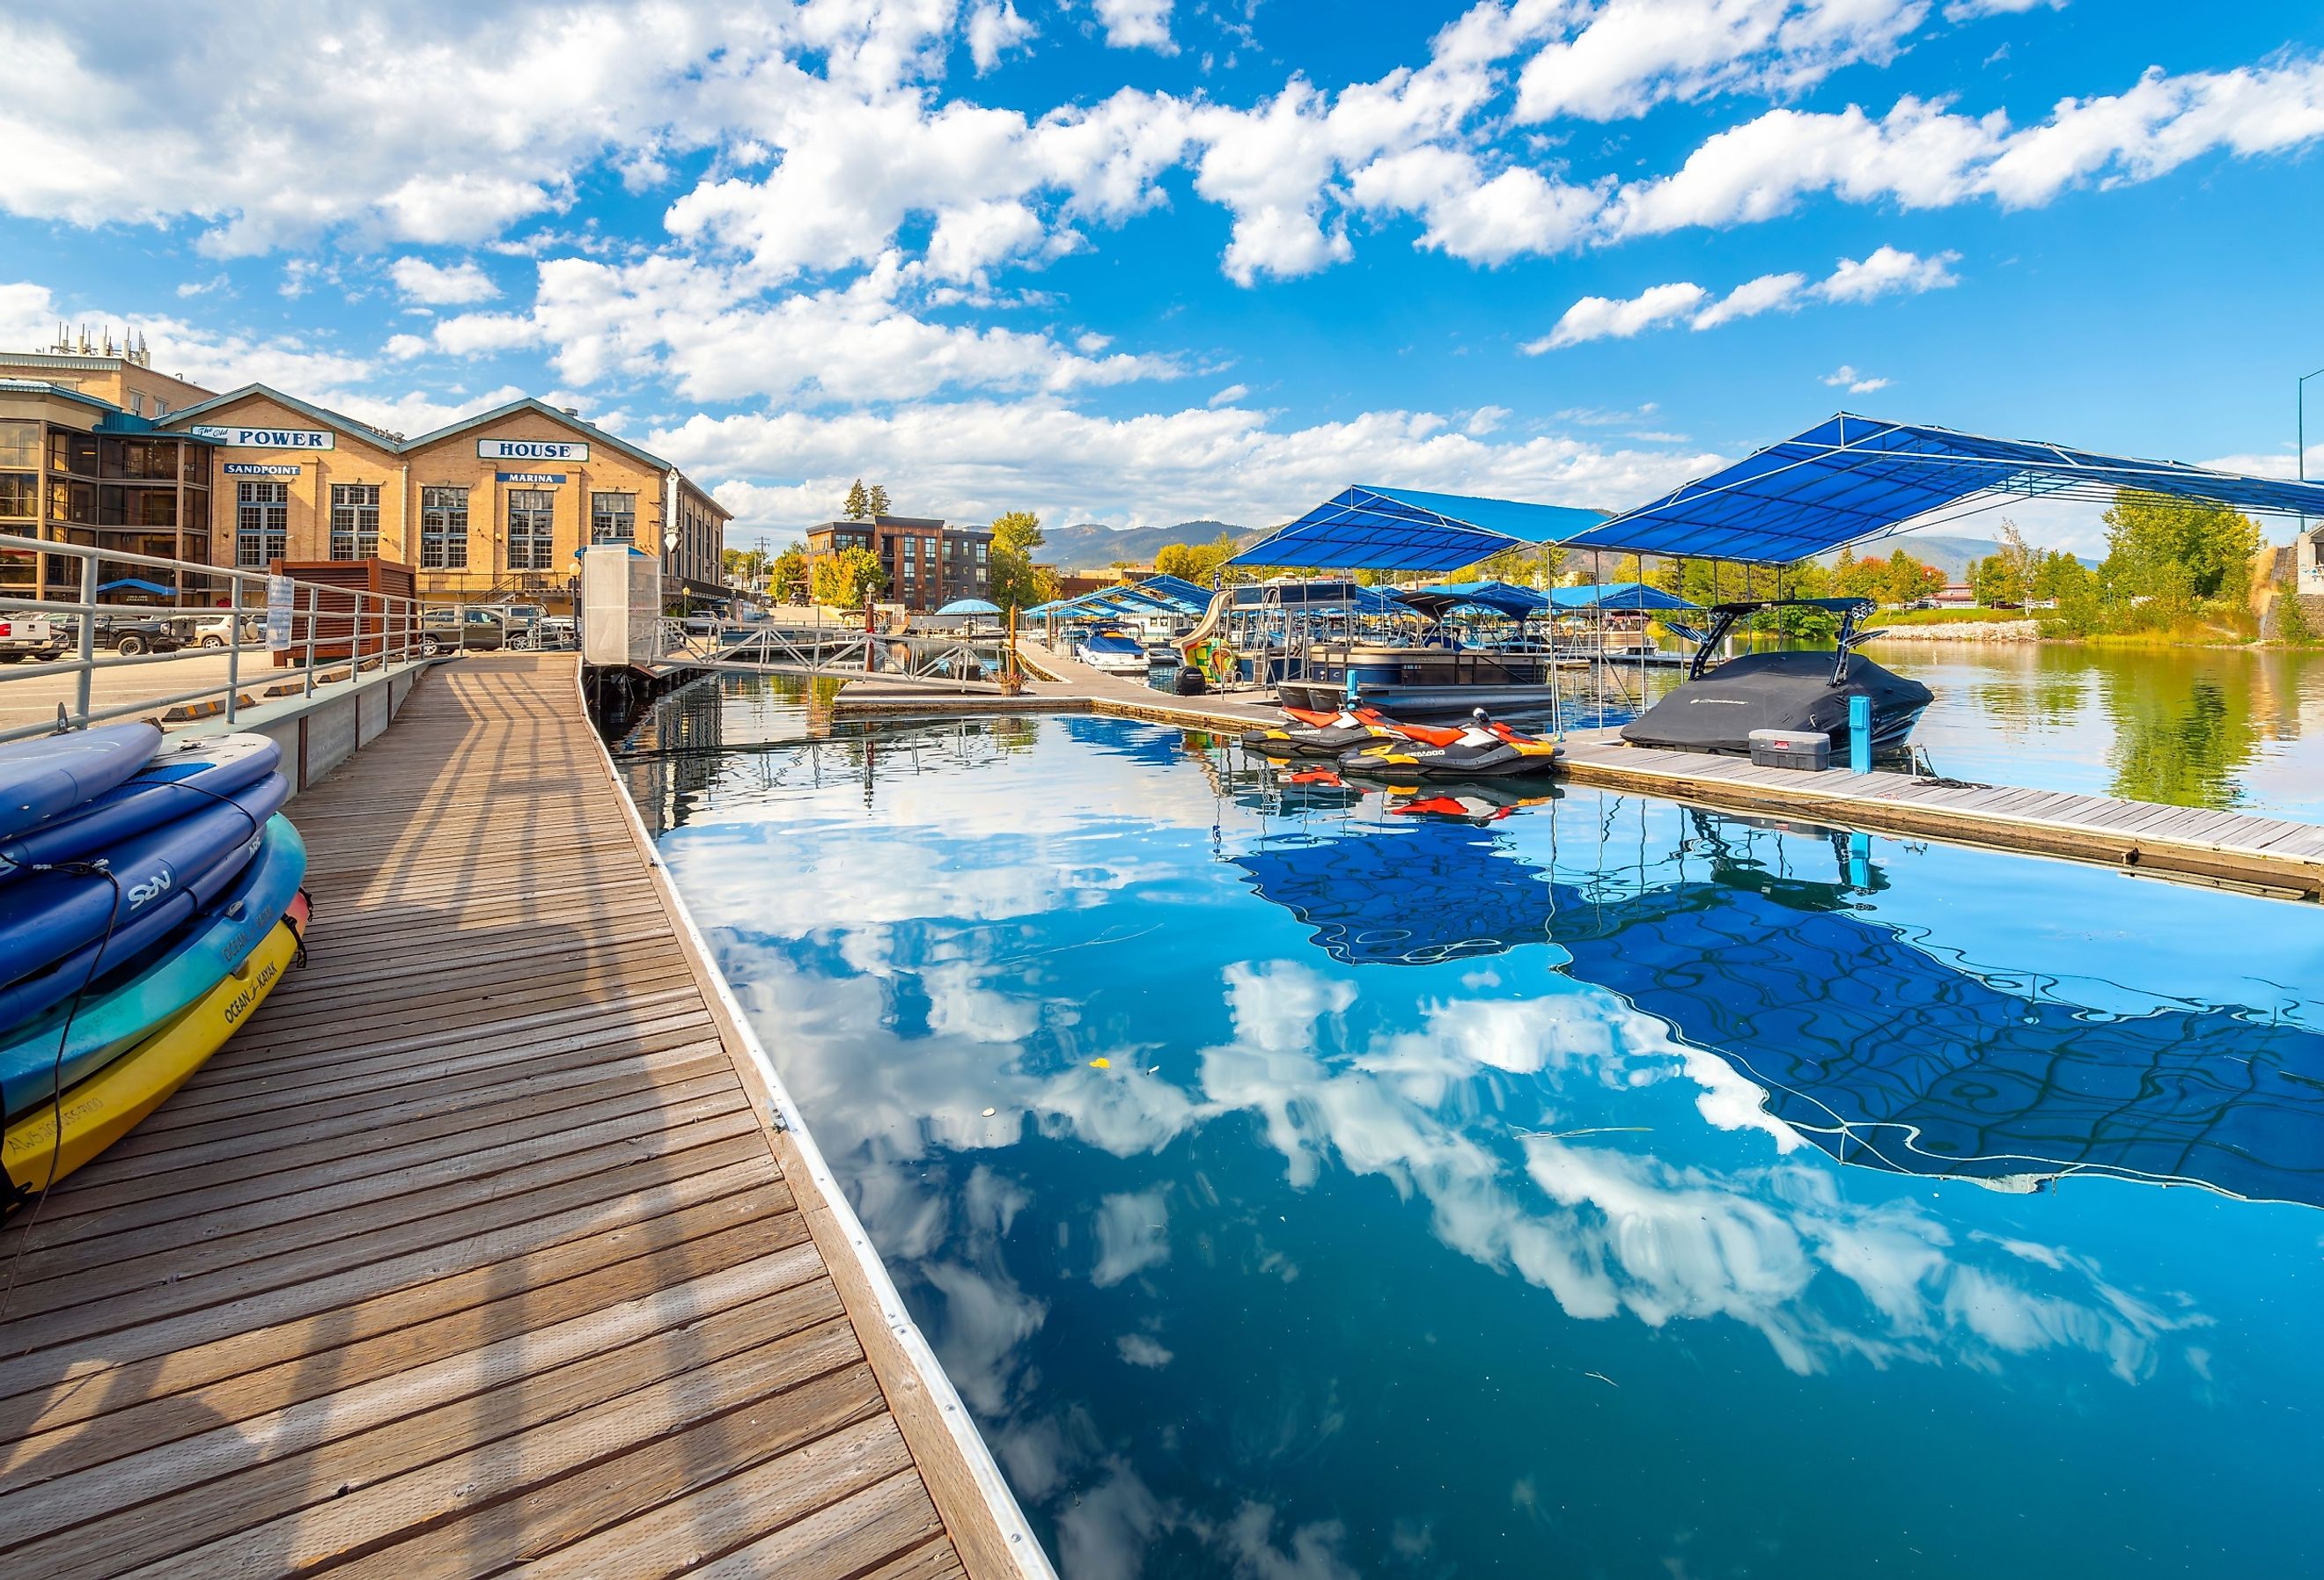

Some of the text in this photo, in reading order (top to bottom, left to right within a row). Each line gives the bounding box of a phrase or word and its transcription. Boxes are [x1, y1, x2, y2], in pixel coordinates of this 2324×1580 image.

[212, 429, 229, 437] Old
[239, 430, 323, 447] POWER
[499, 443, 571, 458] HOUSE
[227, 465, 298, 475] SANDPOINT
[509, 474, 554, 483] MARINA
[128, 870, 172, 911] NRS
[224, 960, 277, 1024] OCEAN KAYAK
